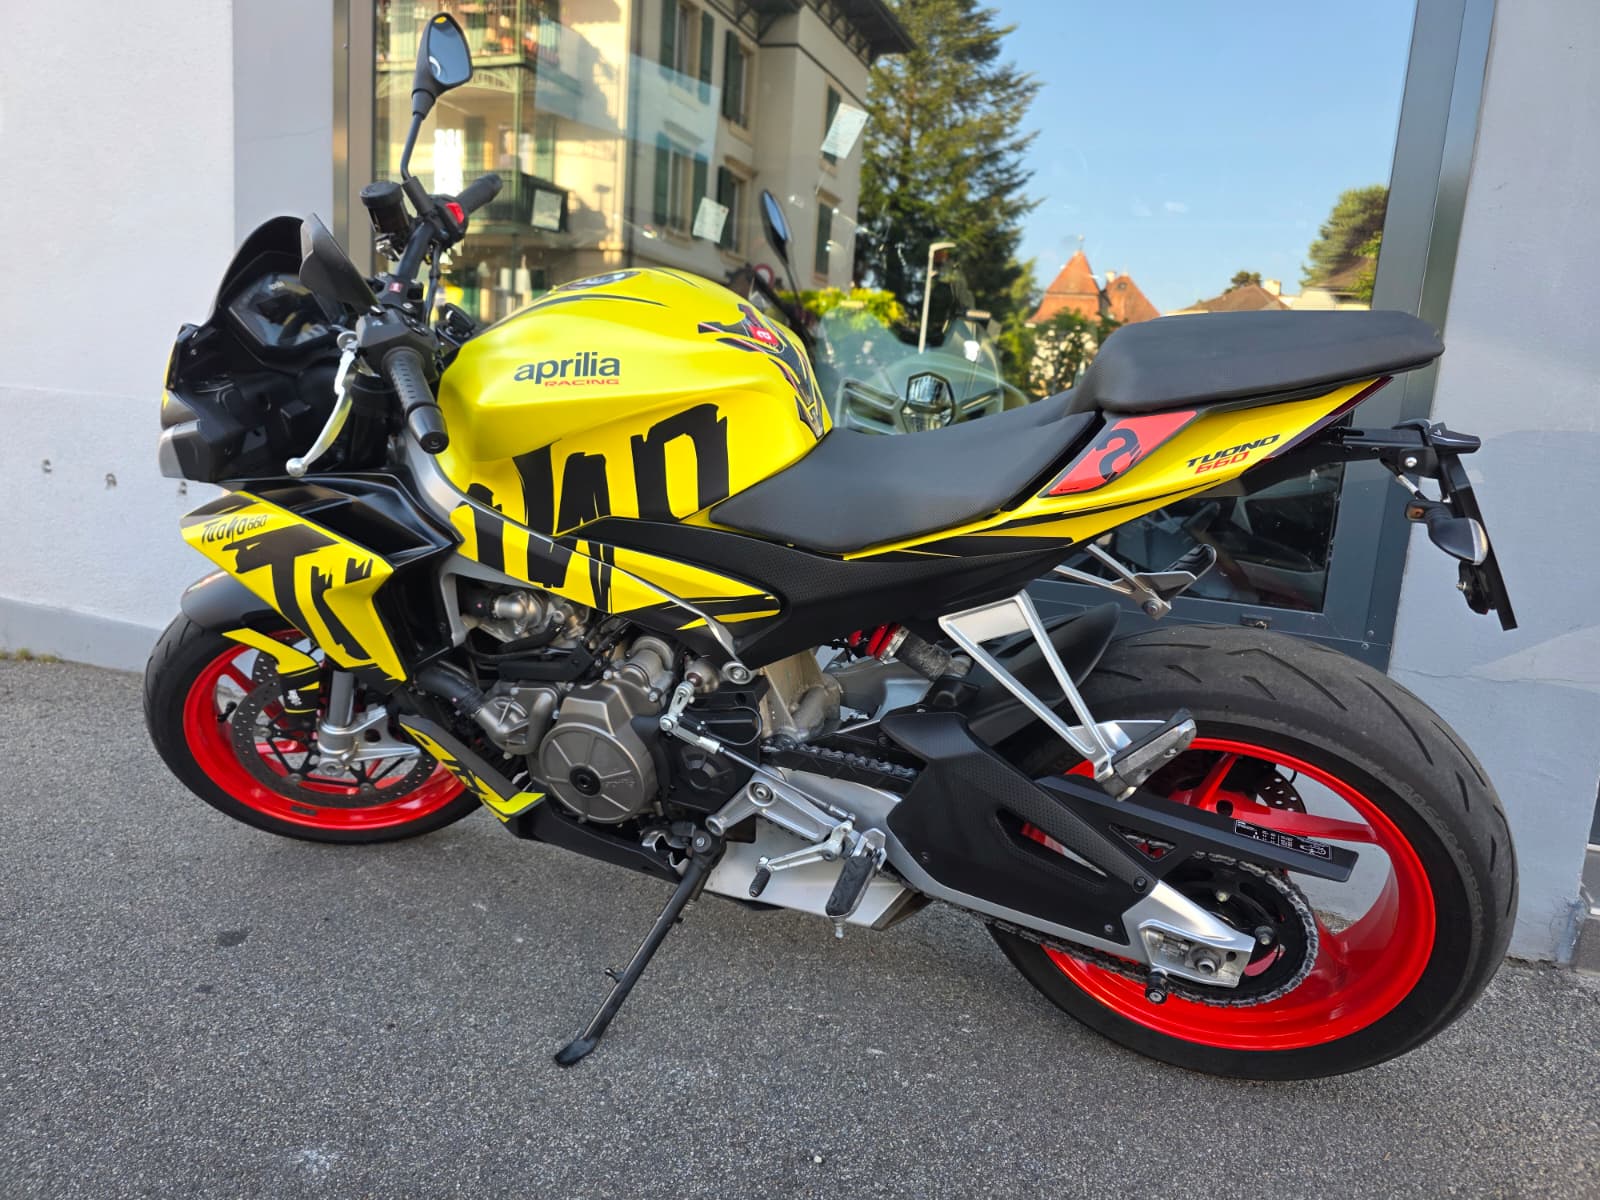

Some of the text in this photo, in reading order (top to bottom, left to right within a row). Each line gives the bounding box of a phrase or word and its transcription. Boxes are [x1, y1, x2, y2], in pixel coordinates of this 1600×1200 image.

[514, 351, 620, 384] aprilia
[544, 379, 619, 387] RACING
[1187, 434, 1280, 467] TUONO
[1195, 451, 1249, 474] 660
